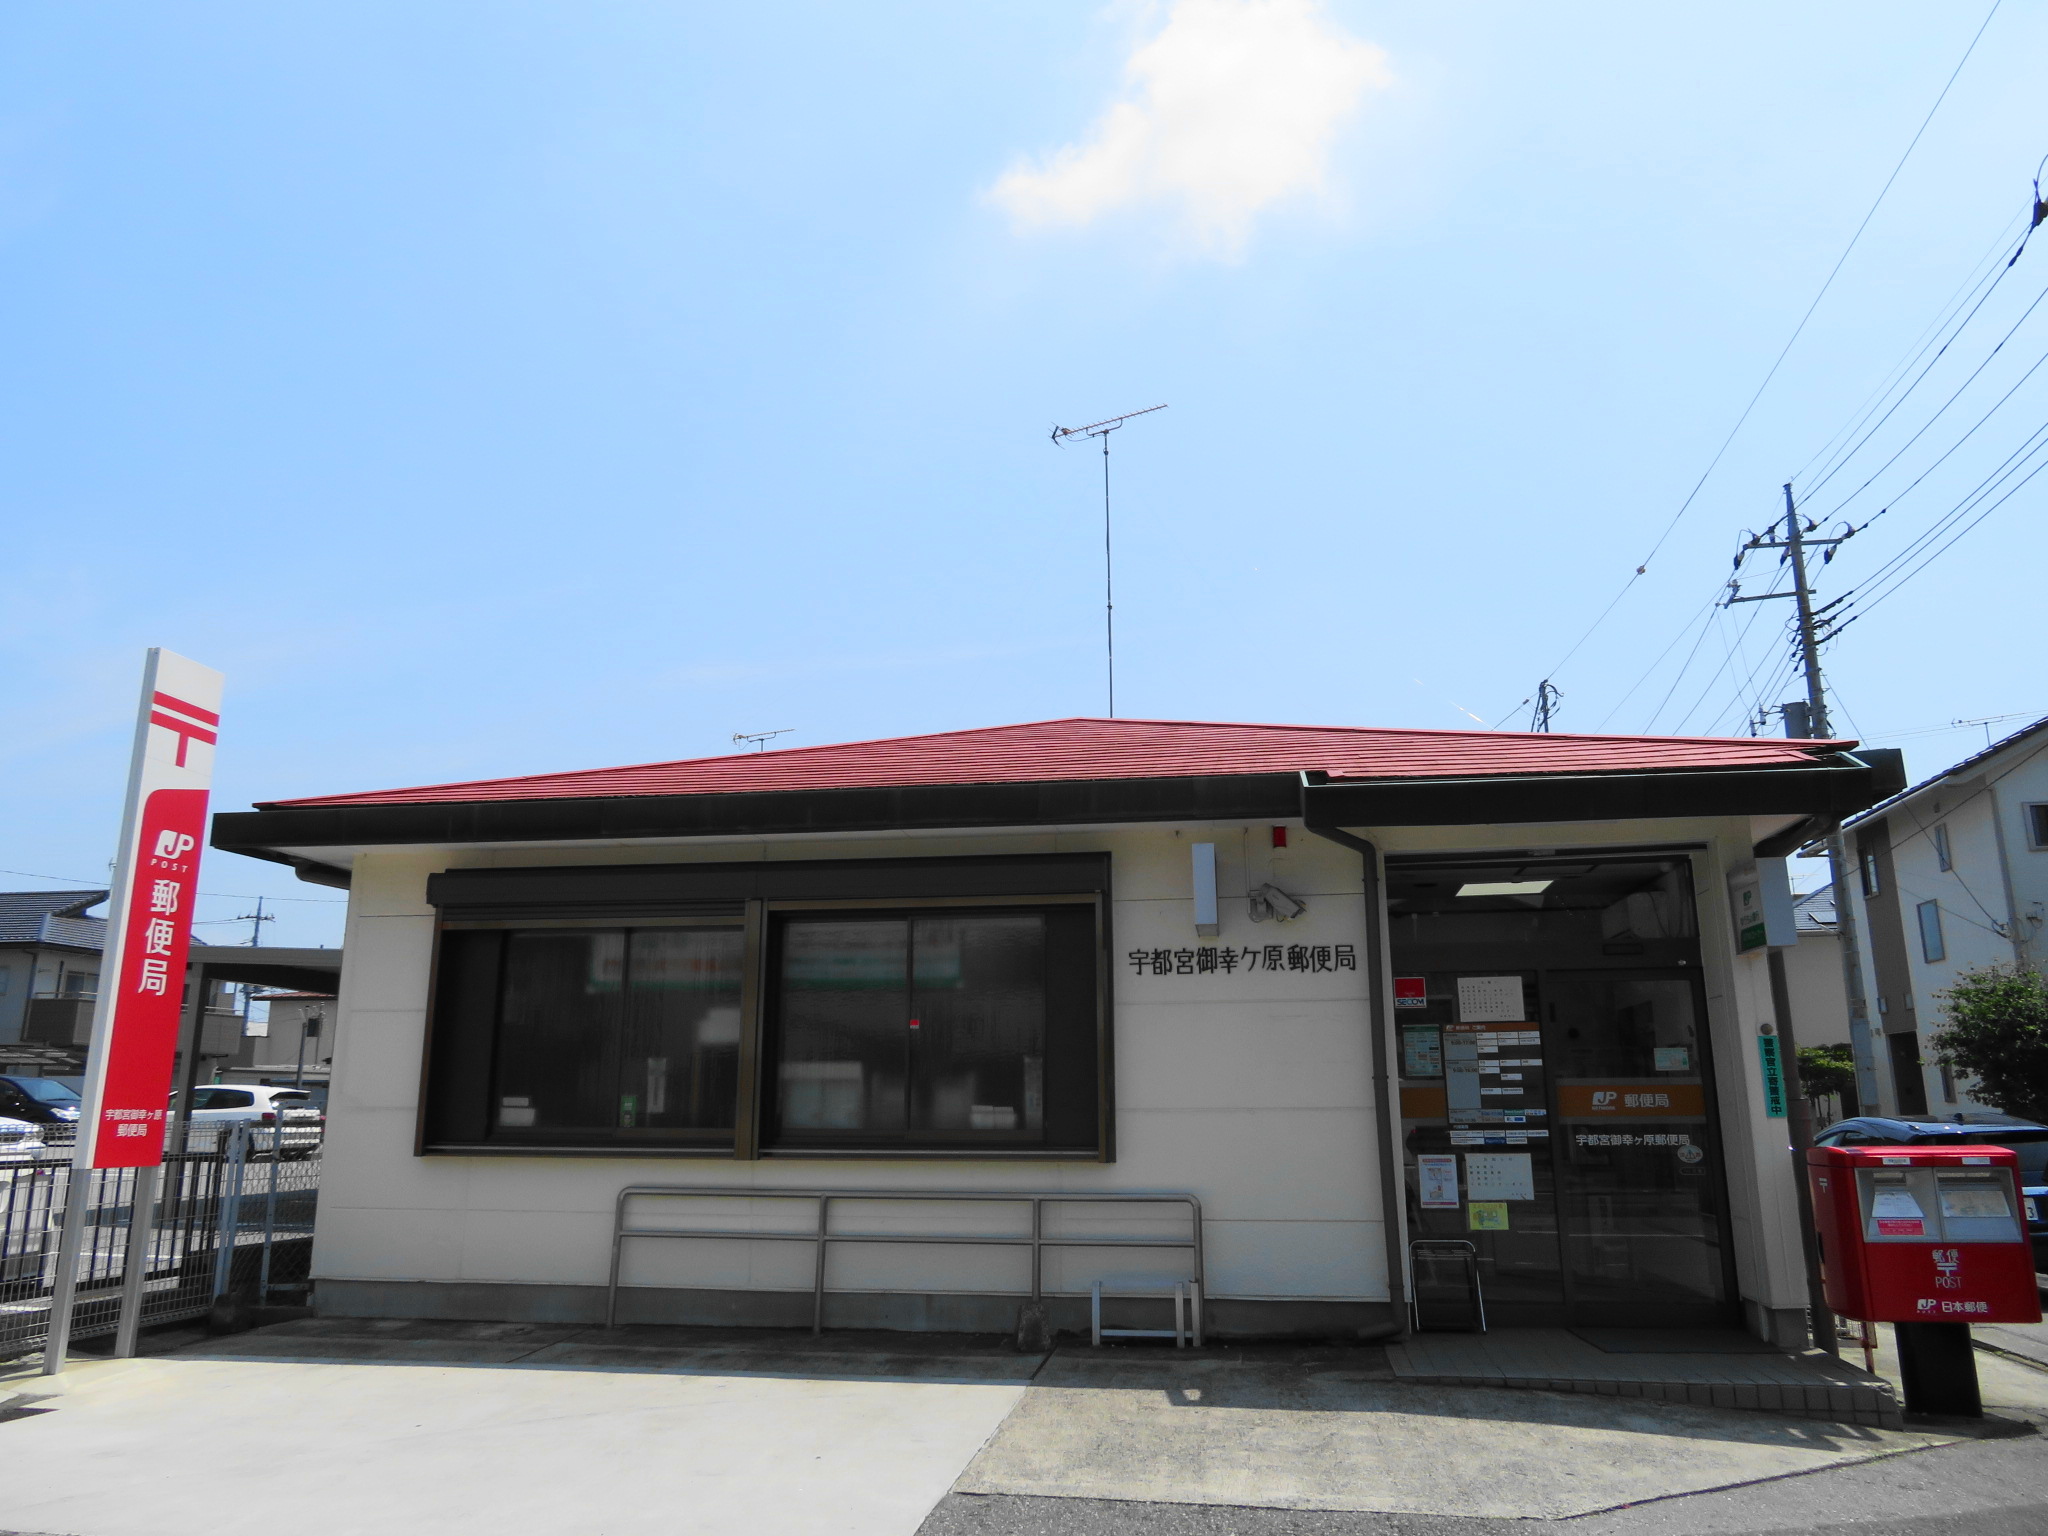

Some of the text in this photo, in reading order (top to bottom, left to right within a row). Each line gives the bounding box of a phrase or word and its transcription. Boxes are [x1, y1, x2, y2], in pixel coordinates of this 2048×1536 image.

[150, 857, 189, 873] POST
[137, 878, 180, 997] 郵便局
[1396, 998, 1425, 1006] SECOM
[1624, 1093, 1670, 1108] 郵便局
[116, 1123, 148, 1138] 郵便局
[1931, 1249, 1960, 1264] 郵便
[1935, 1276, 1963, 1289] POST
[1941, 1301, 1989, 1313] 日本郵便
